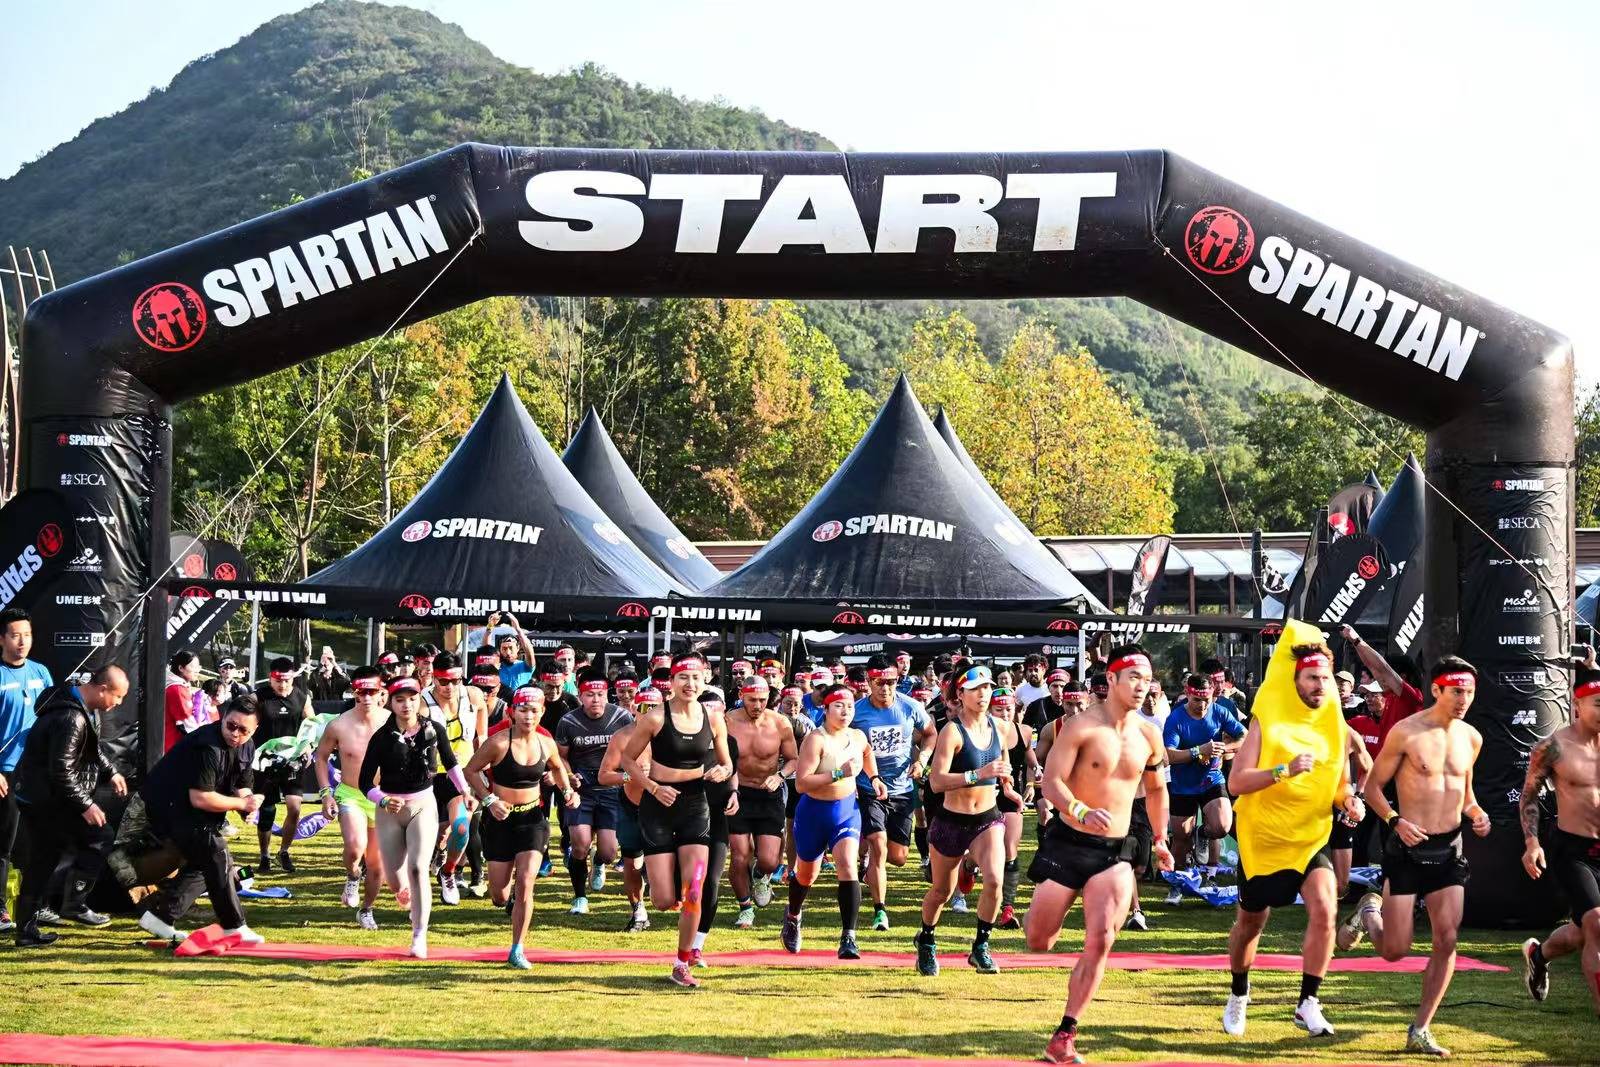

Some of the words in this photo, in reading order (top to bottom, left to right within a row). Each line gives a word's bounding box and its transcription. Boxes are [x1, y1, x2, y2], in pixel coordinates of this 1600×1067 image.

[518, 170, 1117, 254] START
[202, 196, 450, 328] SPARTAN
[1248, 235, 1480, 382] SPARTAN
[69, 434, 113, 447] SPARTAN
[74, 473, 107, 486] SECA
[1505, 479, 1544, 491] SPARTAN
[432, 518, 542, 545] SPARTAN
[844, 514, 955, 542] SPARTAN
[1511, 517, 1541, 529] SECA
[853, 642, 884, 653] SPARTAN
